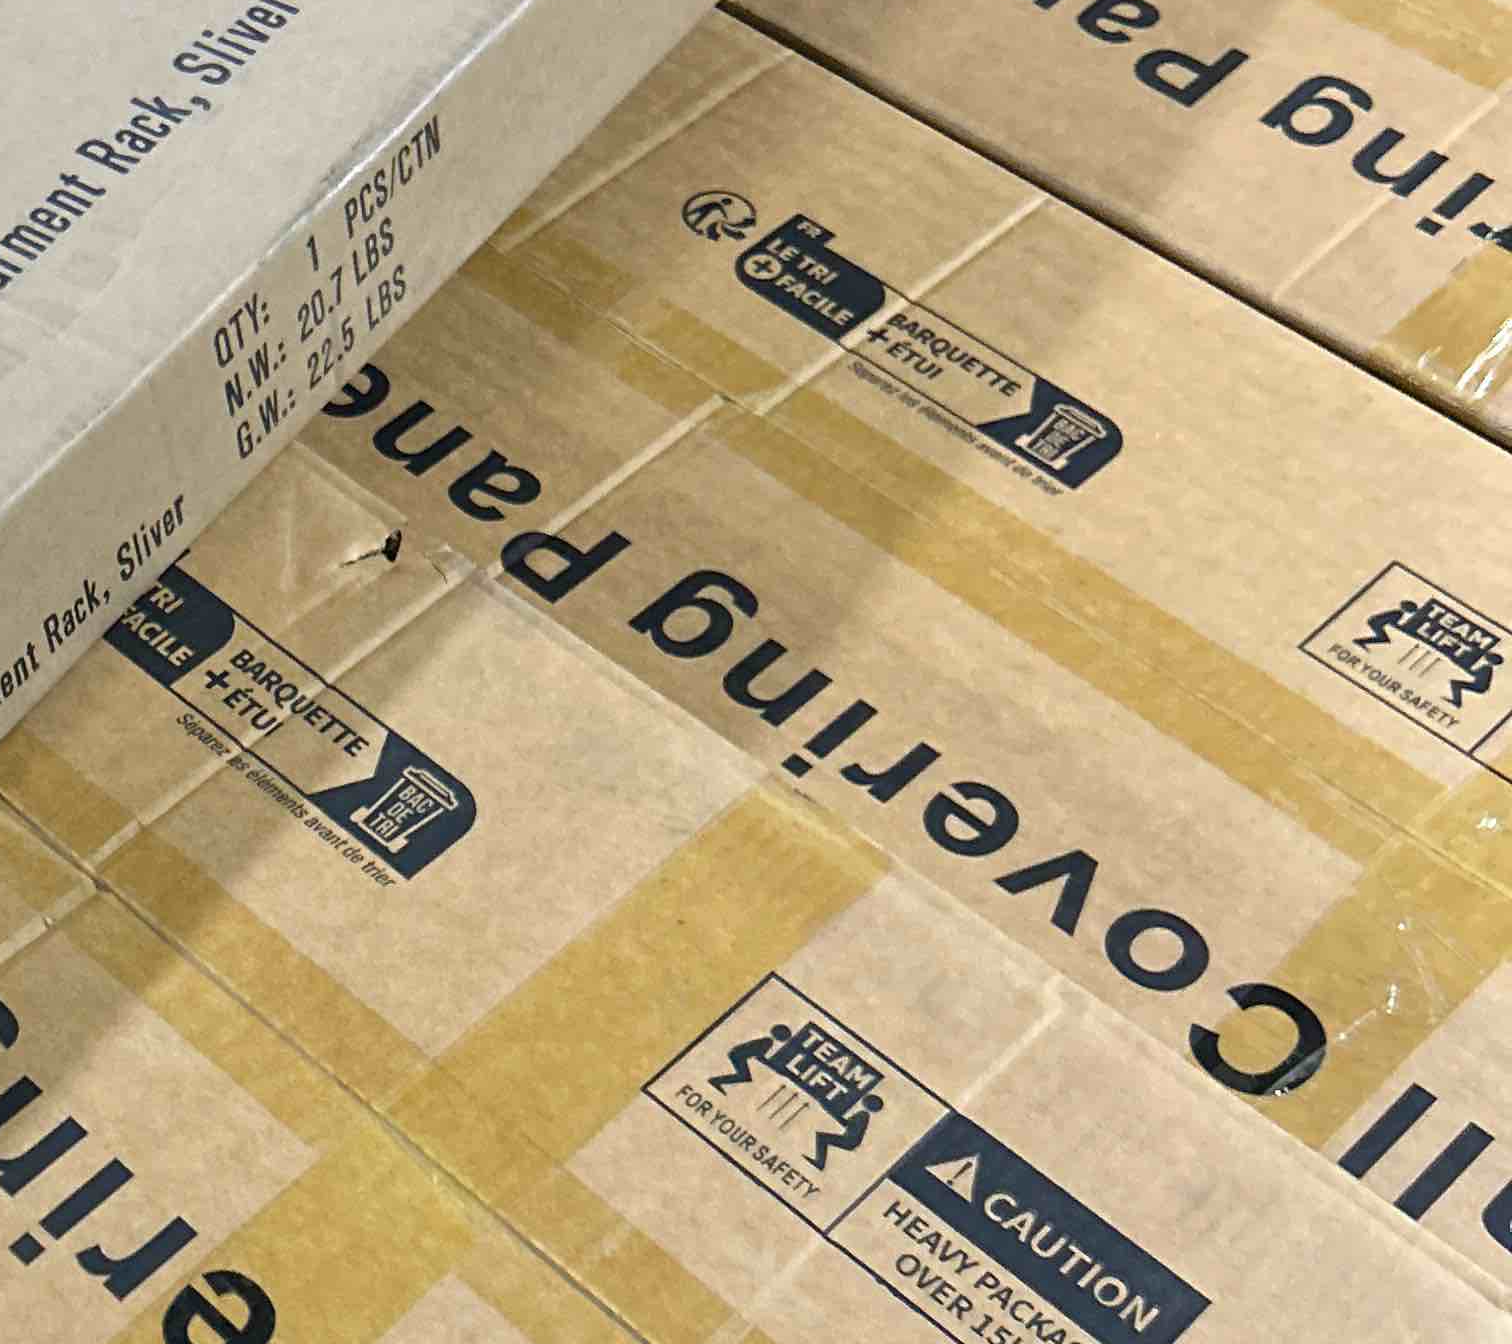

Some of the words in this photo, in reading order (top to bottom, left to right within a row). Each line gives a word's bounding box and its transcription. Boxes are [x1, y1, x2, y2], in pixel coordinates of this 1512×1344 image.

[213, 292, 272, 368] QTY:
[305, 234, 320, 273] 1
[343, 115, 443, 240] PCS/CTN
[766, 238, 800, 262] LE
[796, 256, 839, 285] TRI
[223, 338, 288, 418] N.W.:
[297, 266, 344, 344] 20.7
[352, 217, 396, 288] LBS
[775, 274, 855, 327] FACILE
[235, 387, 298, 459] G.W.:
[307, 316, 356, 391] 22.5
[365, 262, 408, 332] LBS
[887, 312, 1023, 398] BARQUETTE
[887, 340, 945, 380] ÉTUI
[42, 582, 113, 655] Rack,
[115, 493, 187, 583] Sliver
[1416, 621, 1474, 658] LIFT
[1427, 602, 1494, 650] TEAM
[222, 686, 285, 738] ÉTUI
[229, 648, 371, 758] BARQUETTE
[1327, 643, 1362, 669] FOR
[1360, 661, 1403, 695] YOUR
[1398, 688, 1461, 730] SAFETY
[303, 815, 347, 851] avant
[368, 812, 400, 841] TRI
[386, 802, 415, 825] DE
[397, 785, 435, 815] BAC
[628, 568, 1327, 1096] Covering
[784, 1053, 851, 1105] LIFT
[797, 1028, 879, 1092] TEAM
[673, 1083, 716, 1120] FOR
[708, 1110, 758, 1153] YOUR
[751, 1143, 821, 1202] SAFETY
[881, 1200, 980, 1278] HEAVY
[982, 1189, 1162, 1334] CAUTION
[894, 1254, 978, 1322] OVER
